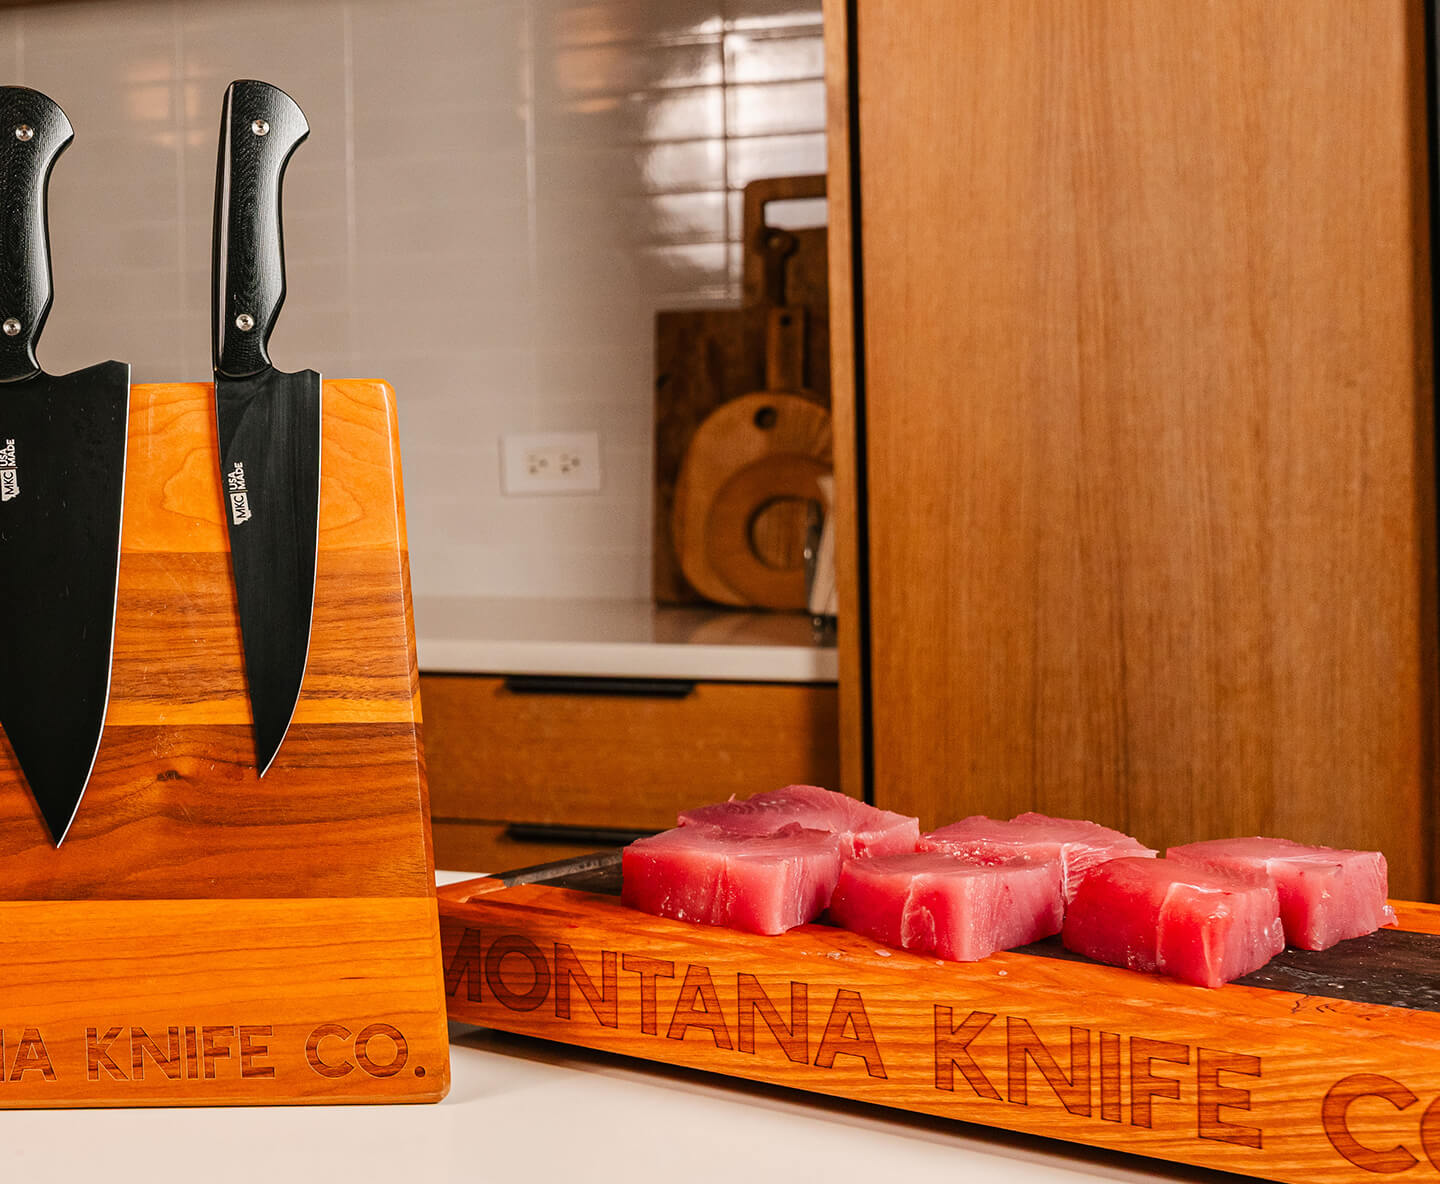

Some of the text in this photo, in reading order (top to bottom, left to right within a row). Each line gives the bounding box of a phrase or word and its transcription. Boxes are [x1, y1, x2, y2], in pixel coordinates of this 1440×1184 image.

[0, 448, 9, 467] USA
[6, 439, 16, 467] MADE
[3, 471, 15, 495] MKC
[228, 471, 238, 490] USA
[234, 462, 246, 490] MADE
[233, 495, 246, 518] MKC
[85, 1024, 276, 1082] KNIFE
[305, 1022, 428, 1080] CO.
[934, 1003, 1263, 1150] KNIFE
[1321, 1072, 1440, 1175] C
